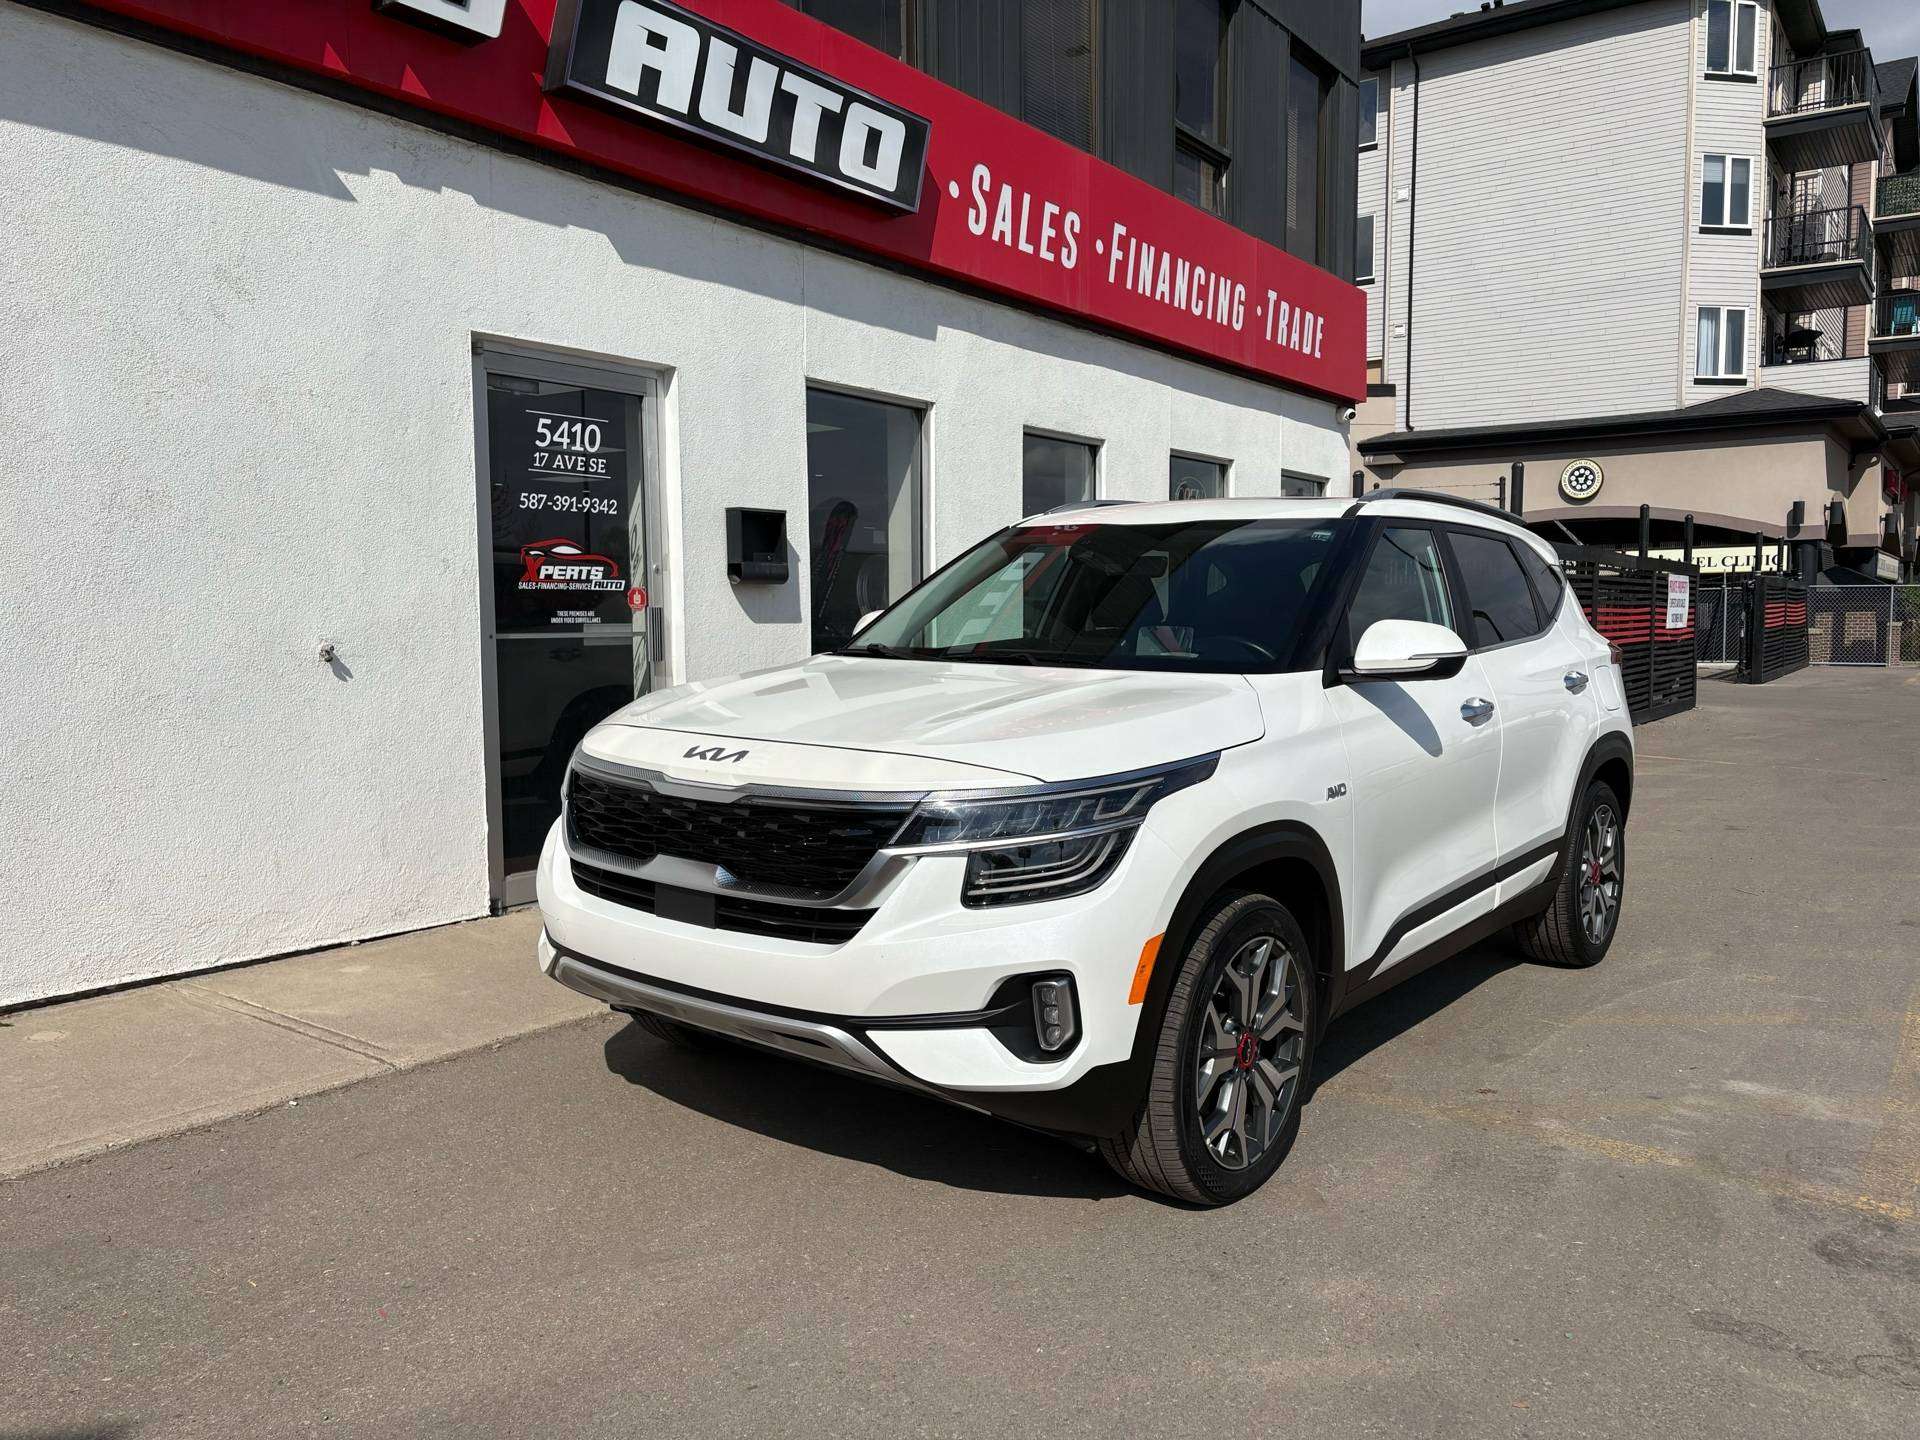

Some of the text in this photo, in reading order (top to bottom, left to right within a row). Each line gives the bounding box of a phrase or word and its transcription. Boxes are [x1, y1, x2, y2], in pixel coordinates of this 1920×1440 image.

[605, 0, 906, 192] AUTO
[968, 163, 1325, 359] SALES FINANCING TRADE
[535, 418, 602, 452] 5410
[533, 451, 607, 473] 17 AVE SE
[519, 491, 618, 515] 587-391-9342
[593, 580, 624, 590] AUTO
[683, 745, 750, 763] KIA
